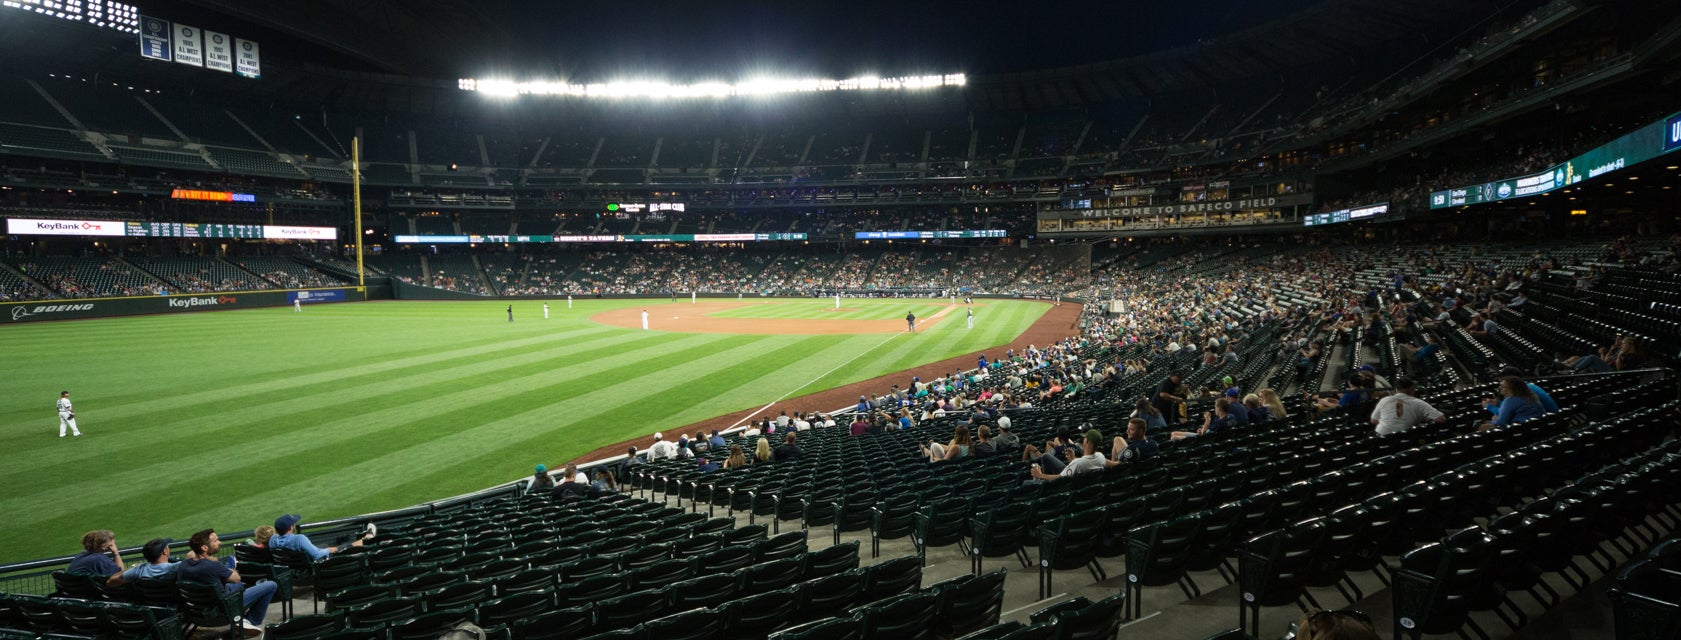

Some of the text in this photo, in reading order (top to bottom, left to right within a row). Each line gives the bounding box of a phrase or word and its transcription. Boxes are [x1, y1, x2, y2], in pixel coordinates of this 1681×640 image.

[186, 48, 198, 56] WEST
[176, 54, 202, 64] CHAMPIONS
[208, 60, 232, 70] CHAMPIONS
[238, 66, 259, 74] CHAMPIONS
[672, 204, 684, 212] CLUB
[1082, 207, 1149, 217] WELCOME
[1180, 201, 1233, 213] SAFECO
[1239, 198, 1276, 209] FIELD
[37, 222, 79, 230] KeyBank
[169, 297, 218, 308] KeyBank
[32, 303, 94, 313] BOEING
